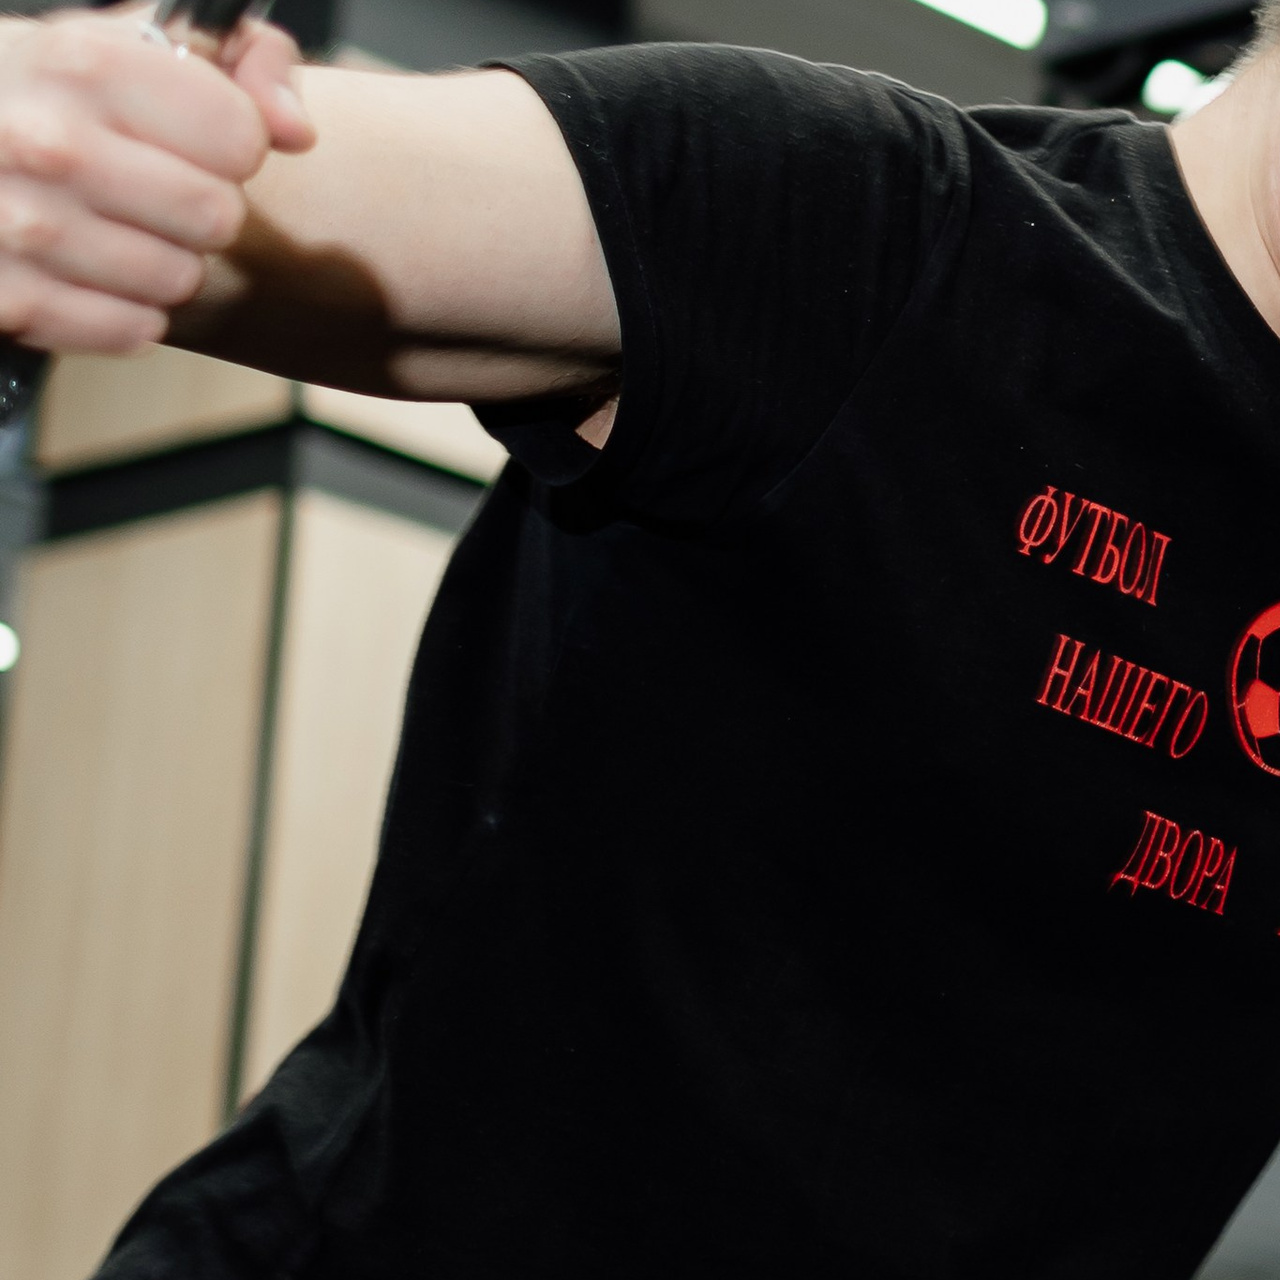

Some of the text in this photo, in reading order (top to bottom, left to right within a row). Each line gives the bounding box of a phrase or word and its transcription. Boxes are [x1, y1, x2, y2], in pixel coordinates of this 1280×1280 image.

[1016, 485, 1172, 607] ФУТБОЛ
[1035, 633, 1209, 760] НАШЕГО
[1109, 810, 1238, 916] ДВОРА
